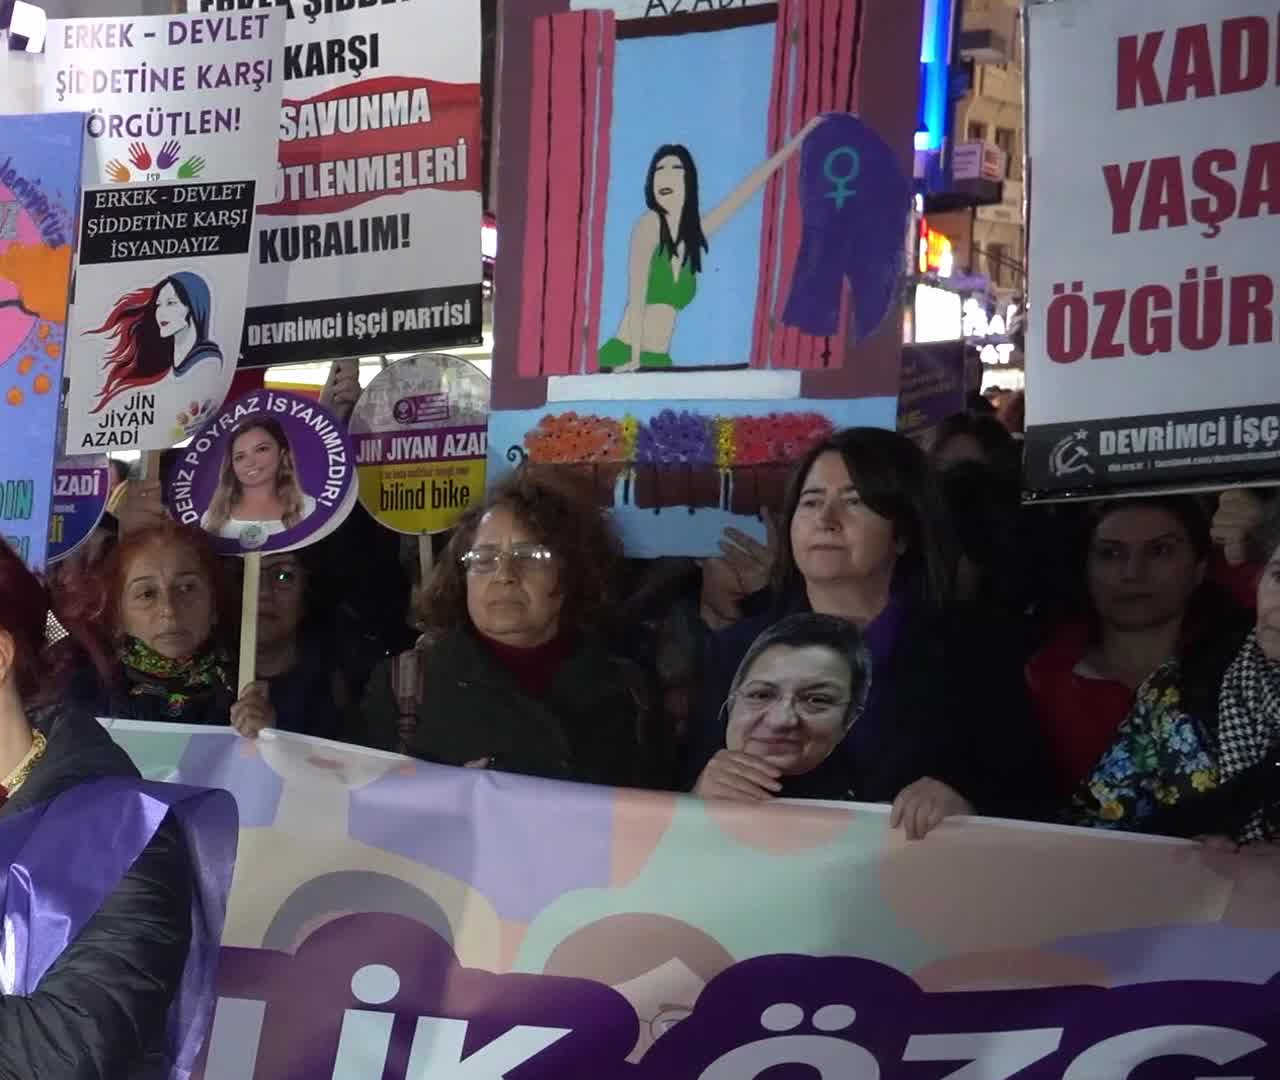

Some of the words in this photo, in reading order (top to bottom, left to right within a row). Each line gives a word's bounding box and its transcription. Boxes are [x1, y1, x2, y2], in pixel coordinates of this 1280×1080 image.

[64, 23, 134, 49] ERKEK
[167, 14, 270, 47] DEVLET
[283, 34, 380, 80] KARŞI
[1116, 16, 1280, 111] KAD
[56, 62, 186, 101] ŞİDDETİNE
[197, 60, 273, 91] KARŞI
[86, 108, 241, 139] ÖRGÜTLEN!
[95, 189, 158, 209] ERKEK
[173, 184, 248, 203] DEVLET
[87, 212, 188, 238] ŞİDDETİNE
[193, 208, 248, 229] KARŞI
[259, 213, 411, 264] KURALIM!
[111, 235, 220, 259] İSYANDAYIZ
[247, 307, 343, 347] DEVRİMCİ
[347, 303, 388, 338] İŞÇİ
[392, 299, 472, 331] PARTİSİ
[1046, 265, 1275, 367] ÖZGÜR
[98, 410, 155, 429] JİYAN
[124, 392, 155, 412] JİN
[81, 428, 139, 448] AZADİ
[184, 396, 260, 465] POYRAZ
[266, 391, 346, 508] İSYANIMIZDIR!
[356, 439, 382, 464] JIN
[386, 433, 438, 462] JIYAN
[442, 431, 487, 457] AZA
[1099, 415, 1227, 456] DEVRİMCİ
[172, 412, 199, 525] DENİZ
[380, 480, 426, 512] bilind
[431, 474, 470, 509] bike
